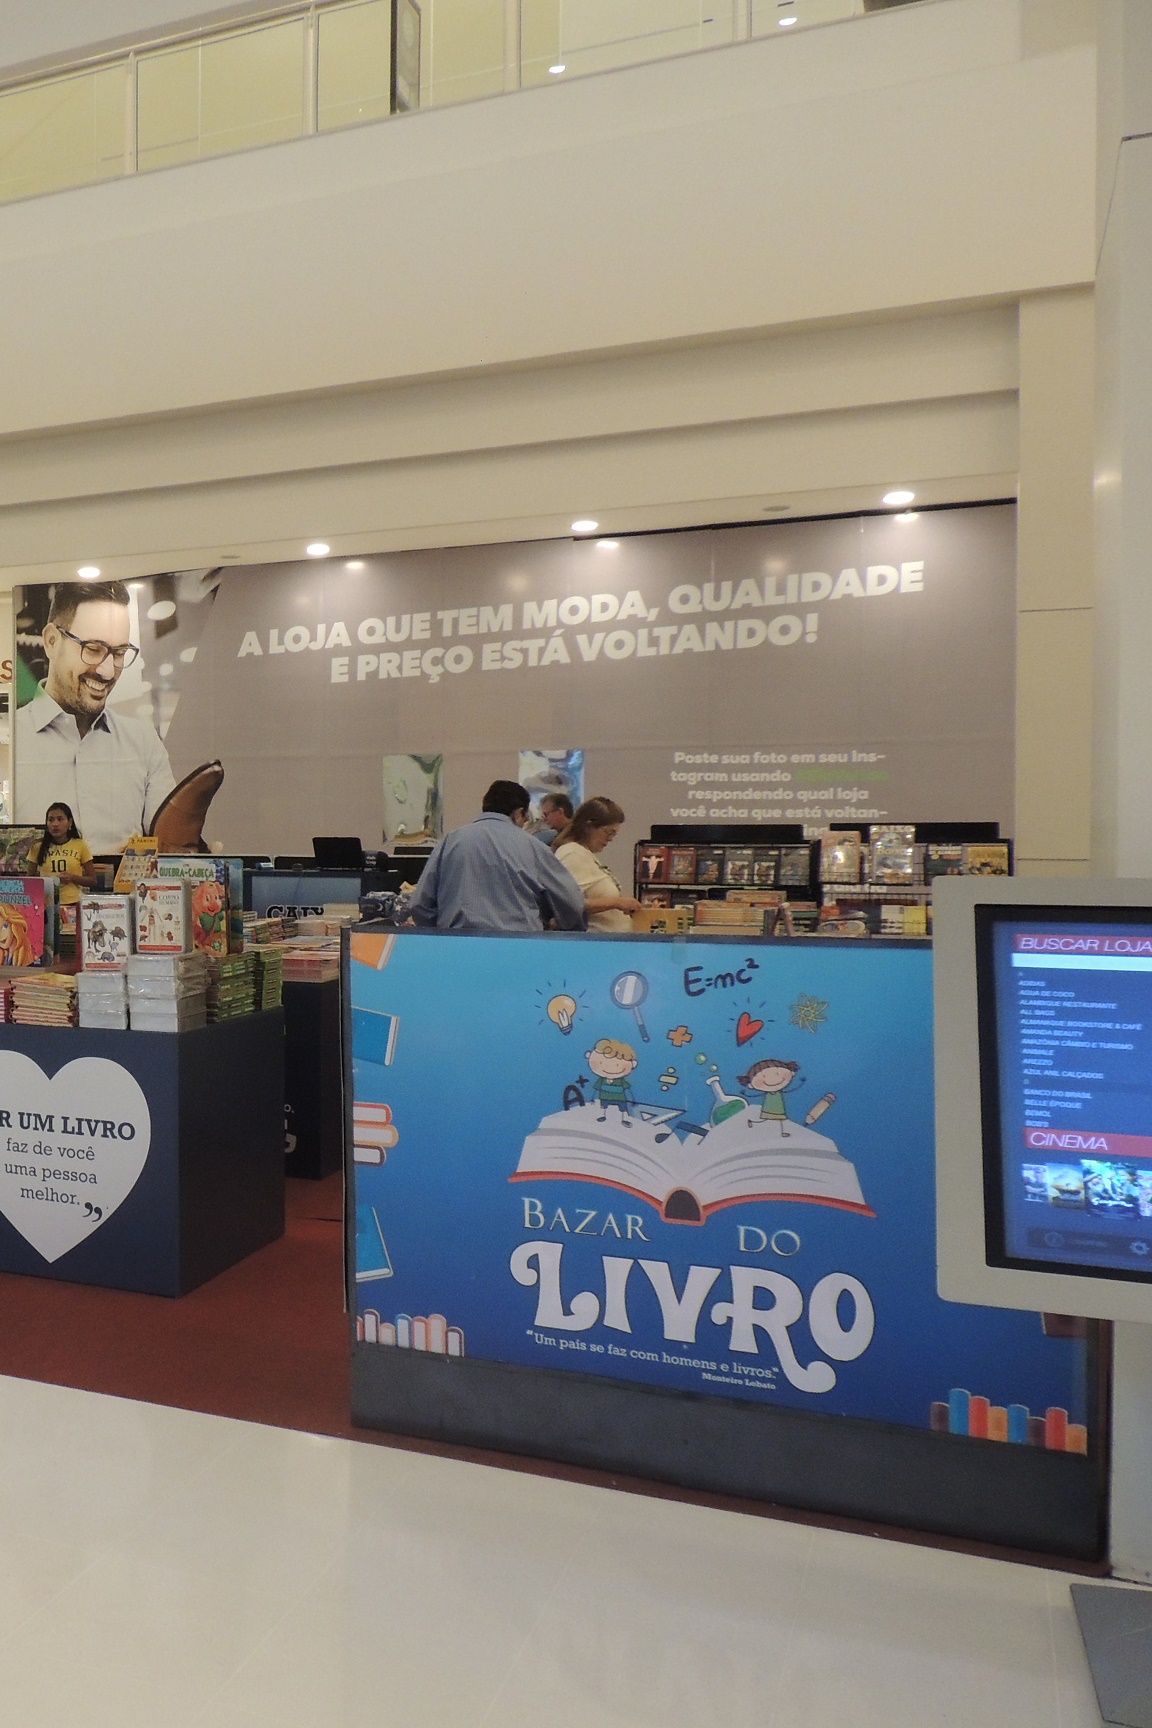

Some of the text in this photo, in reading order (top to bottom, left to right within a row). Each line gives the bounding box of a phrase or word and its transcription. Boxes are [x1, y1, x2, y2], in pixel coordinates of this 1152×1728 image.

[238, 561, 924, 658] A LOJA QUE TEM MODA, QUALIDADE
[331, 613, 819, 683] E PREÇO ESTÁ VOLTANDO!
[674, 752, 718, 764] Poste
[721, 754, 750, 764] sua
[753, 751, 787, 764] foto
[791, 754, 815, 763] em
[819, 753, 848, 763] seu
[670, 770, 728, 785] tagram
[731, 770, 792, 782] usando
[688, 787, 869, 802] respondendo qual loja
[670, 805, 888, 820] você acha que está voltan-
[48, 849, 79, 860] RASIL
[51, 859, 67, 873] 10
[159, 867, 214, 880] QUEBRA-CABEÇA
[1020, 937, 1099, 950] BUSCAR
[1067, 1020, 1114, 1029] BOOKSTORE
[1099, 1042, 1134, 1050] TURISMO
[17, 1111, 55, 1133] UM
[61, 1114, 136, 1141] LIVRO
[6, 1138, 95, 1161] faz de você
[1030, 1132, 1108, 1150] CINEMA
[4, 1162, 98, 1185] uma pessoa
[20, 1186, 80, 1206] melhor.
[521, 1197, 801, 1257] BAZAR DO
[509, 1240, 875, 1393] LIVRO
[590, 1342, 605, 1354] se
[608, 1343, 628, 1358] faz
[630, 1348, 660, 1361] com
[662, 1351, 717, 1371] homens
[720, 1361, 730, 1372] e
[702, 1372, 776, 1390] Monteiro Lobato
